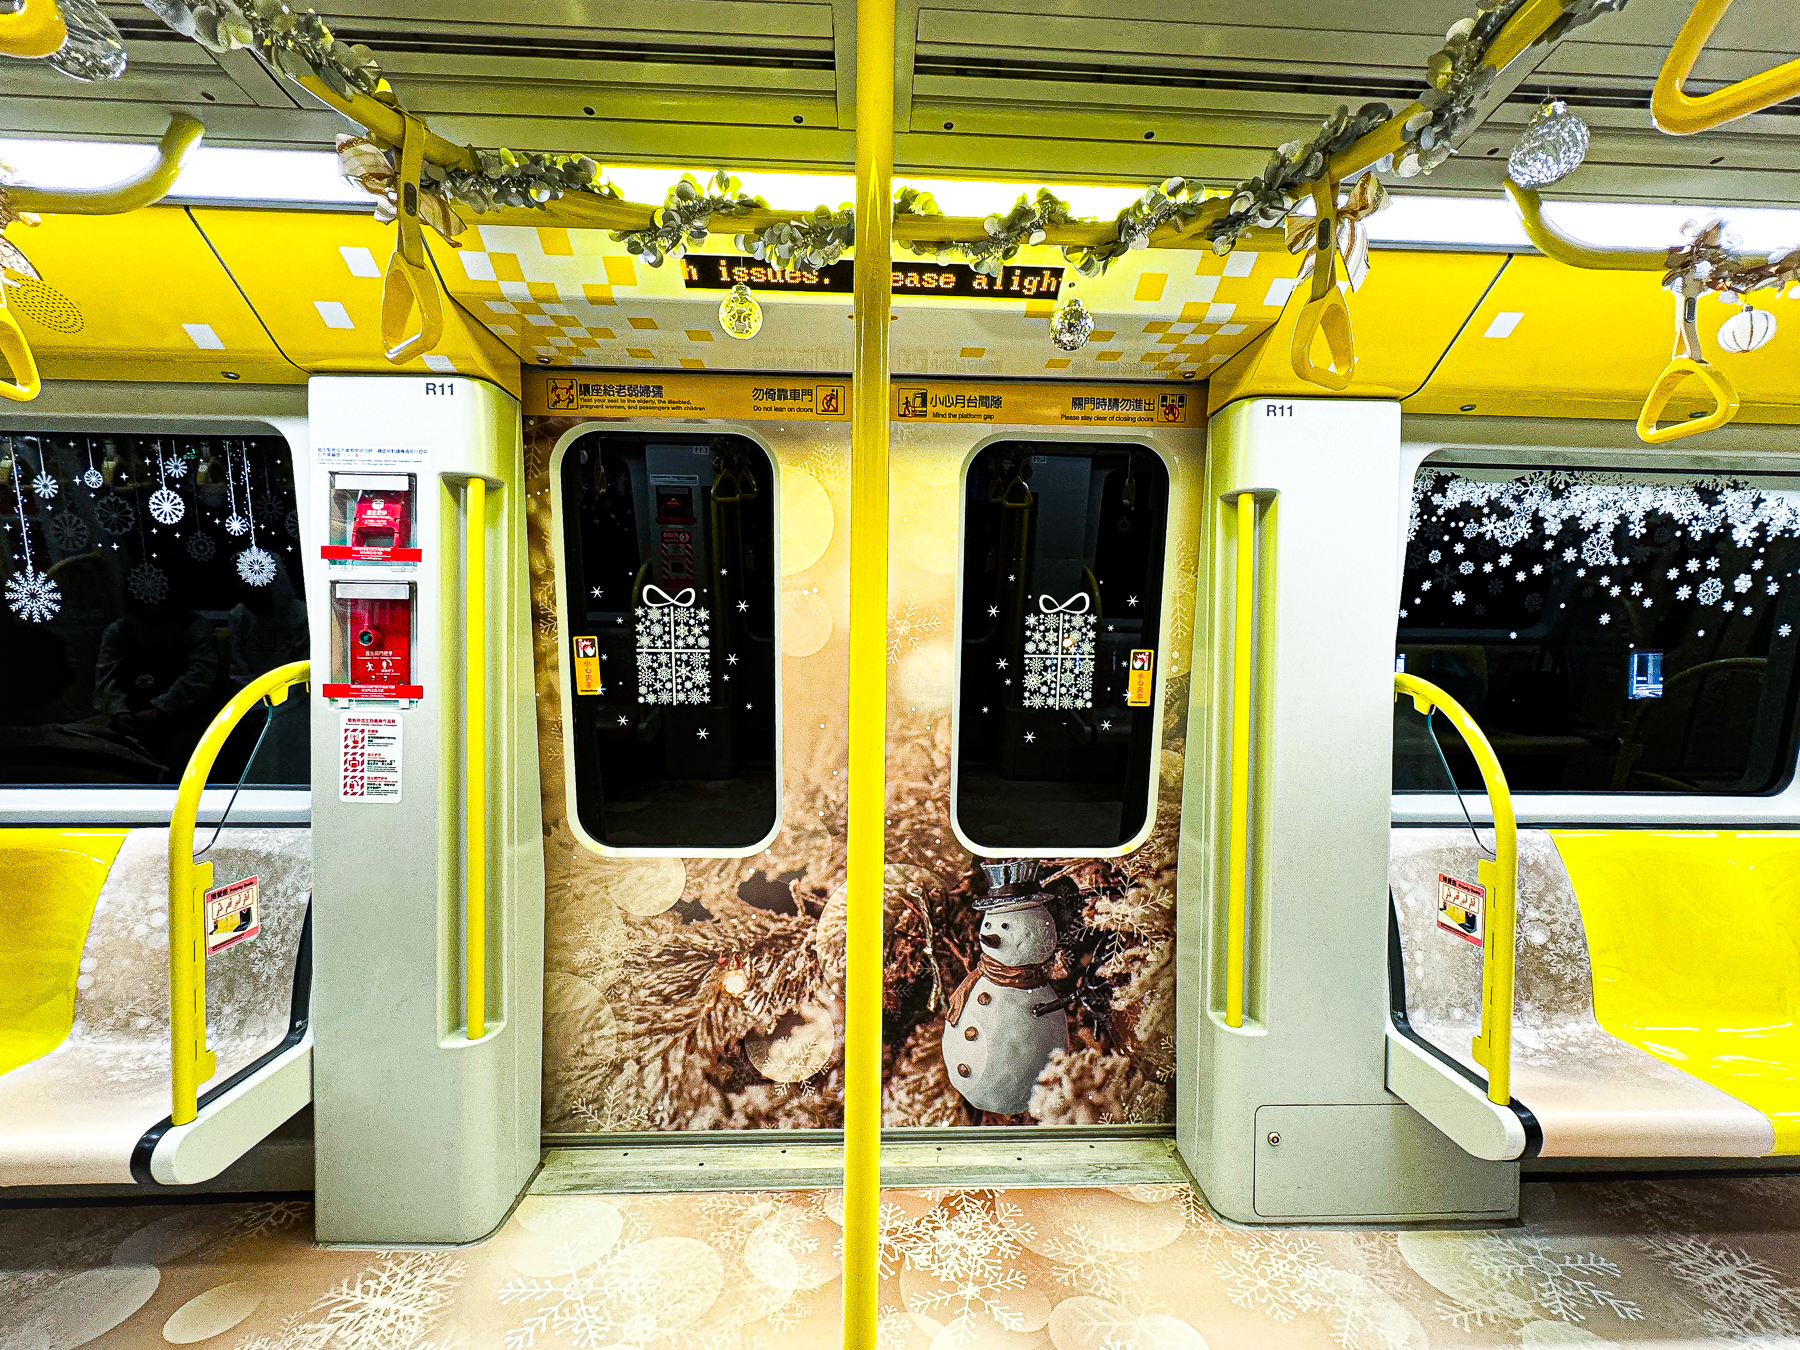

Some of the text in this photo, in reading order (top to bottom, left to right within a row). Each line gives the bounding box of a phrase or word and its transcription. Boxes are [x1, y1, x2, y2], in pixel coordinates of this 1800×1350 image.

[719, 259, 830, 284] issues.
[890, 271, 956, 288] ease
[972, 268, 1058, 295] aligh
[425, 382, 454, 396] R11
[752, 387, 813, 402] 勿倚靠車門
[930, 394, 1003, 409] 小心月台間隙
[1071, 396, 1155, 412] 關門時請勿進出
[958, 412, 983, 420] platform
[983, 413, 995, 421] gap
[1266, 404, 1293, 417] R11
[1080, 414, 1093, 422] stay
[1115, 415, 1137, 423] closing
